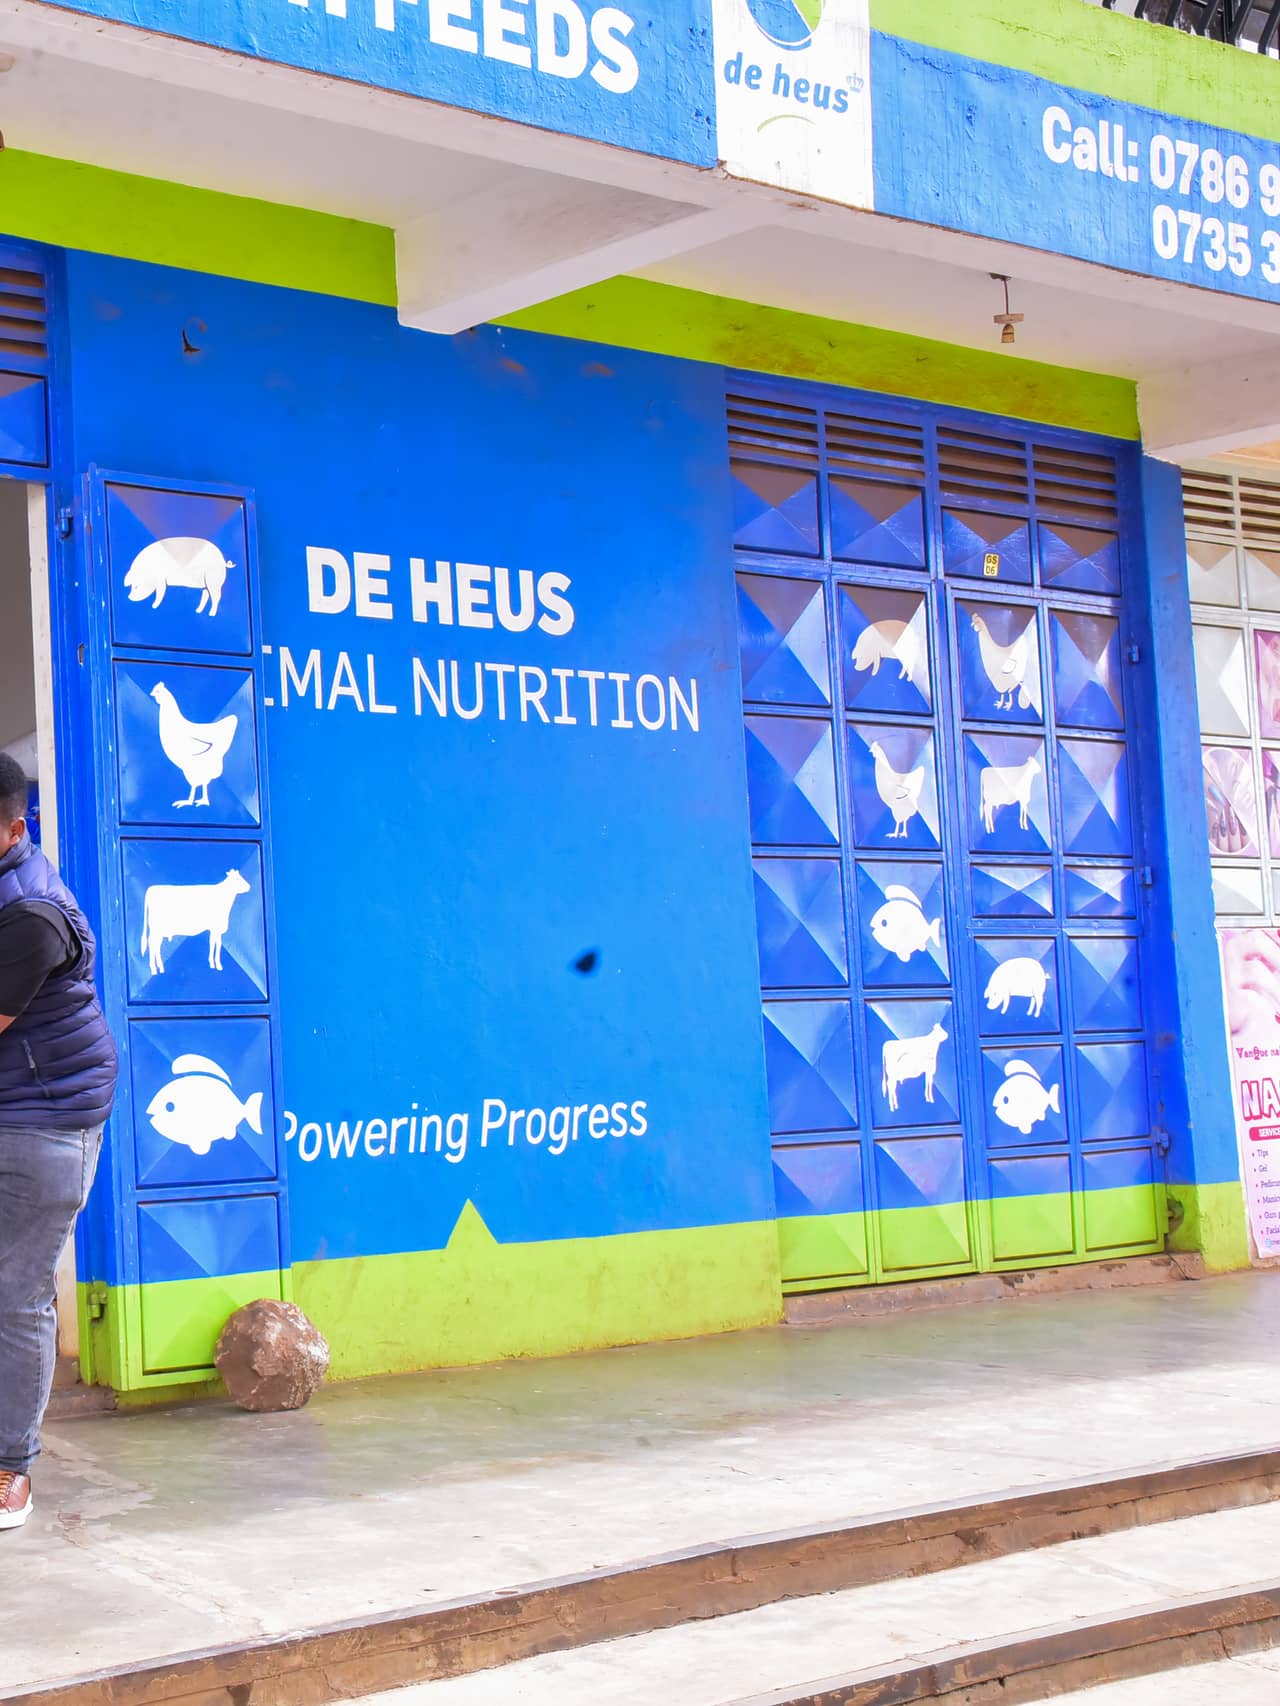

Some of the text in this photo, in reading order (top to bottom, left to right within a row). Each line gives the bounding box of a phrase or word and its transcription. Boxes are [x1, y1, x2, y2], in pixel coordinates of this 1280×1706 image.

[724, 51, 849, 113] de heus
[1042, 105, 1139, 183] Call:
[1149, 134, 1250, 209] 0786
[1152, 204, 1252, 277] 0735
[306, 545, 575, 636] DE HEUS
[412, 657, 700, 733] NUTRITION
[481, 1098, 648, 1155] Progress
